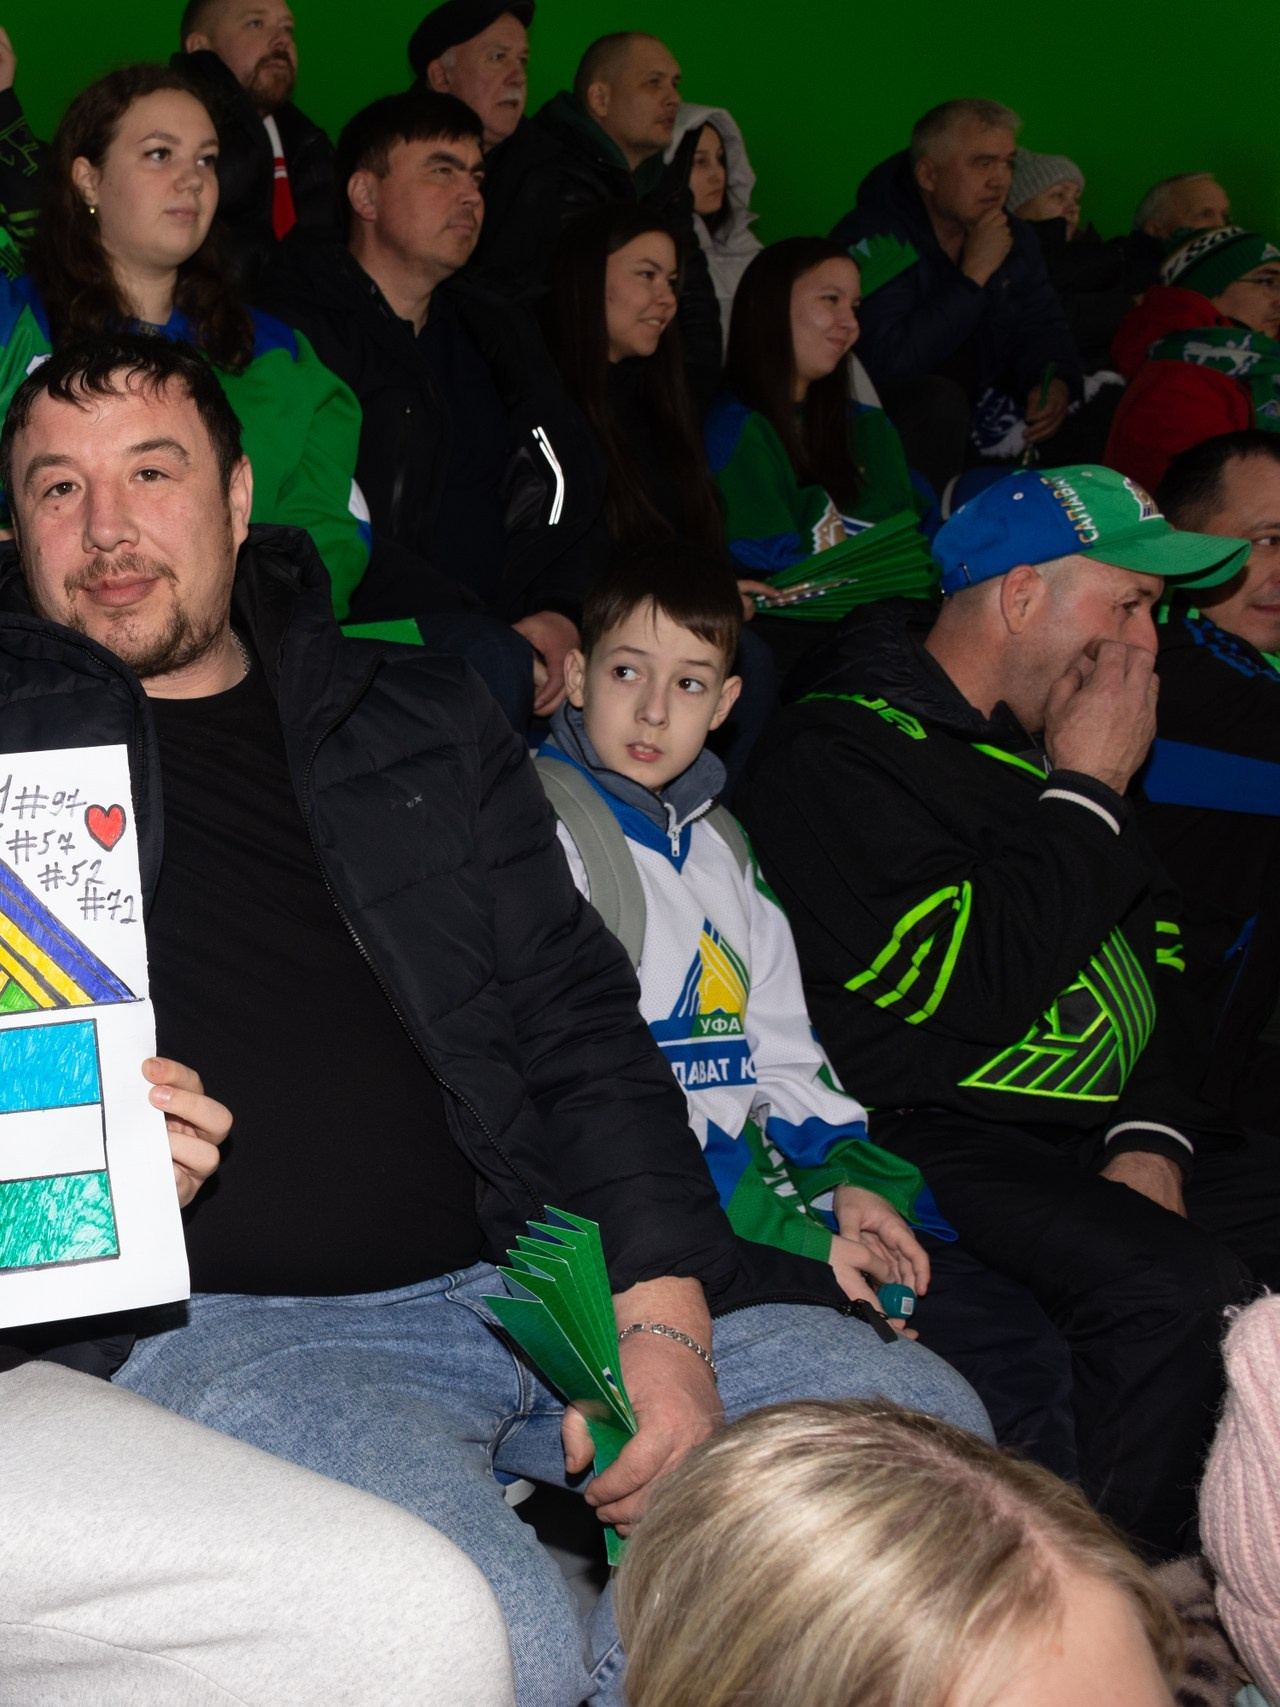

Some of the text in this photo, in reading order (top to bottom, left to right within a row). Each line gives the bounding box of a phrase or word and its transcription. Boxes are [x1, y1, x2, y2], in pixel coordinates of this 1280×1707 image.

[6, 829, 75, 865] #57
[37, 859, 106, 891] #52
[77, 887, 137, 924] #72
[700, 1017, 741, 1034] УФА
[671, 1058, 730, 1086] ЛАВАТ
